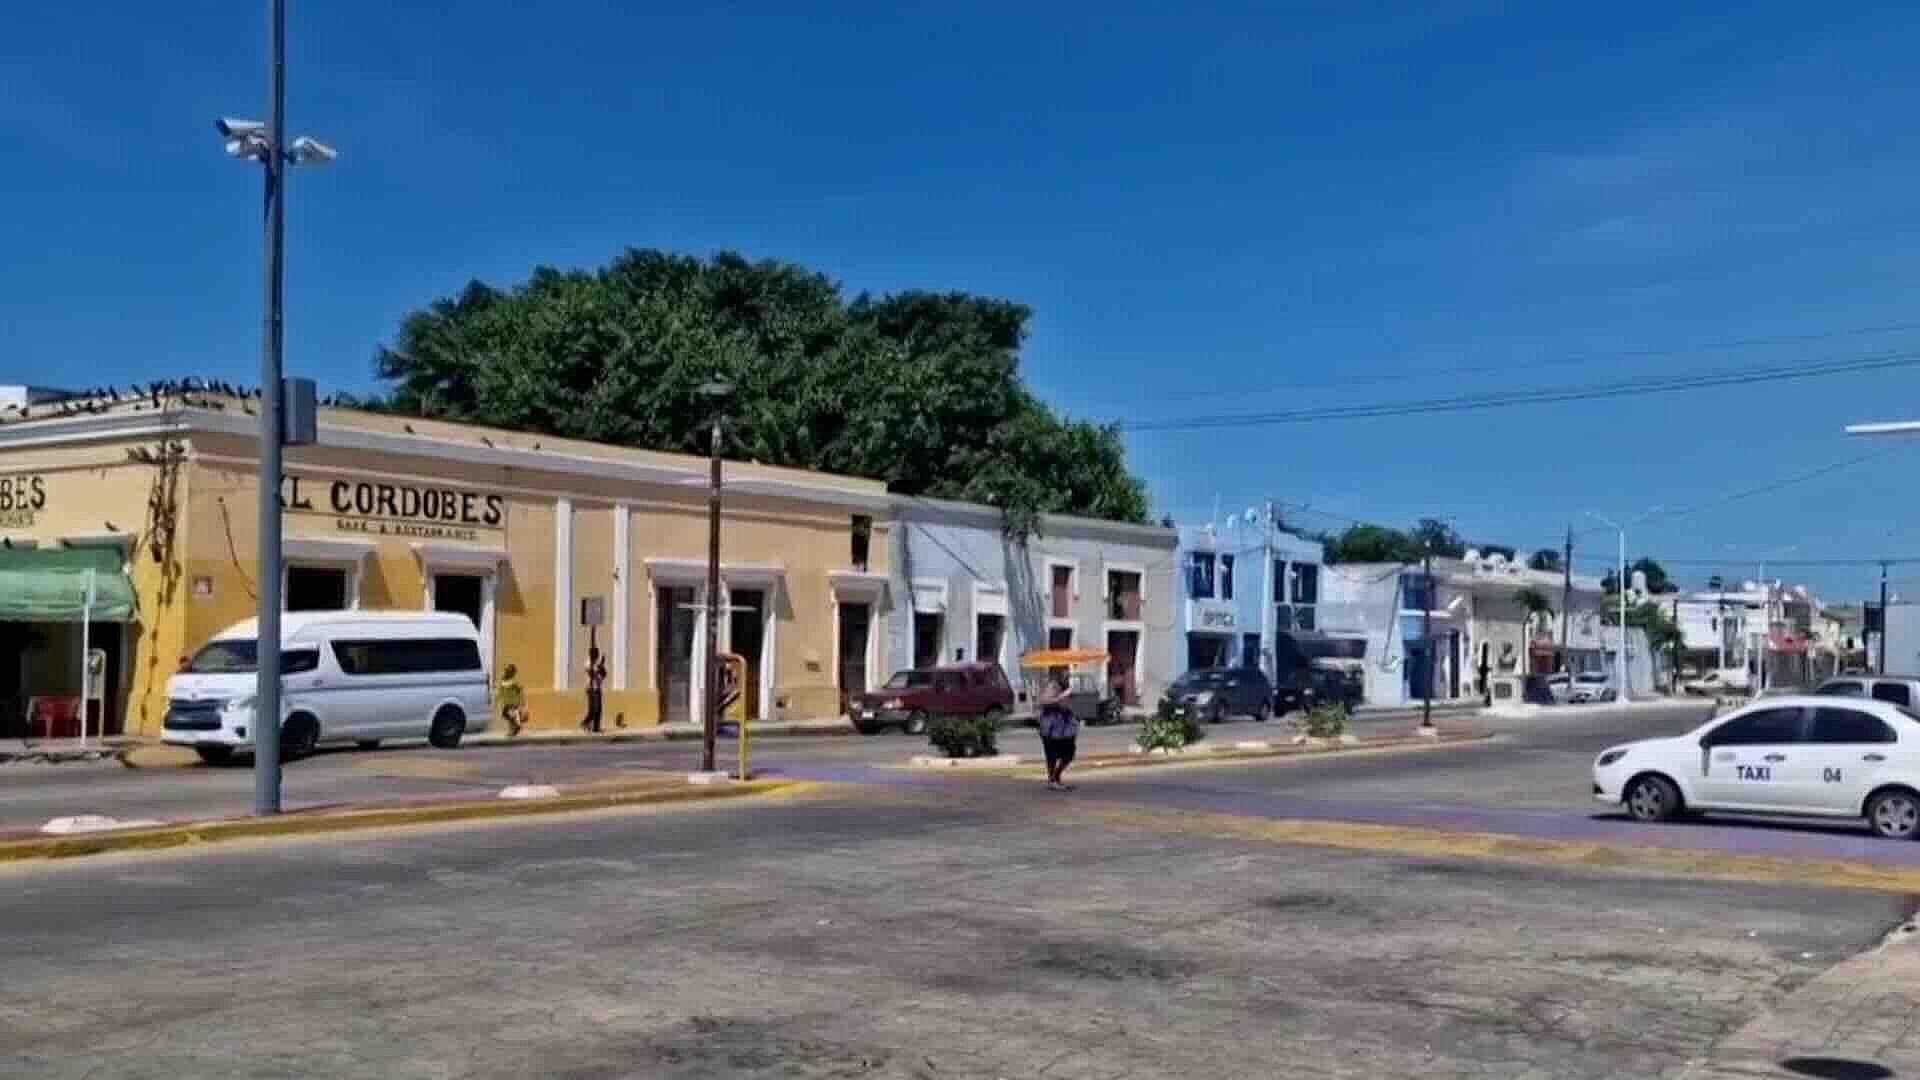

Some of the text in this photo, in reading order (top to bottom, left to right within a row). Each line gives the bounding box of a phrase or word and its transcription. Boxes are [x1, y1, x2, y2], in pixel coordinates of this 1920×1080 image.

[330, 479, 503, 525] CORDOBES
[1736, 765, 1771, 781] TAXI
[1823, 767, 1842, 782] 04
